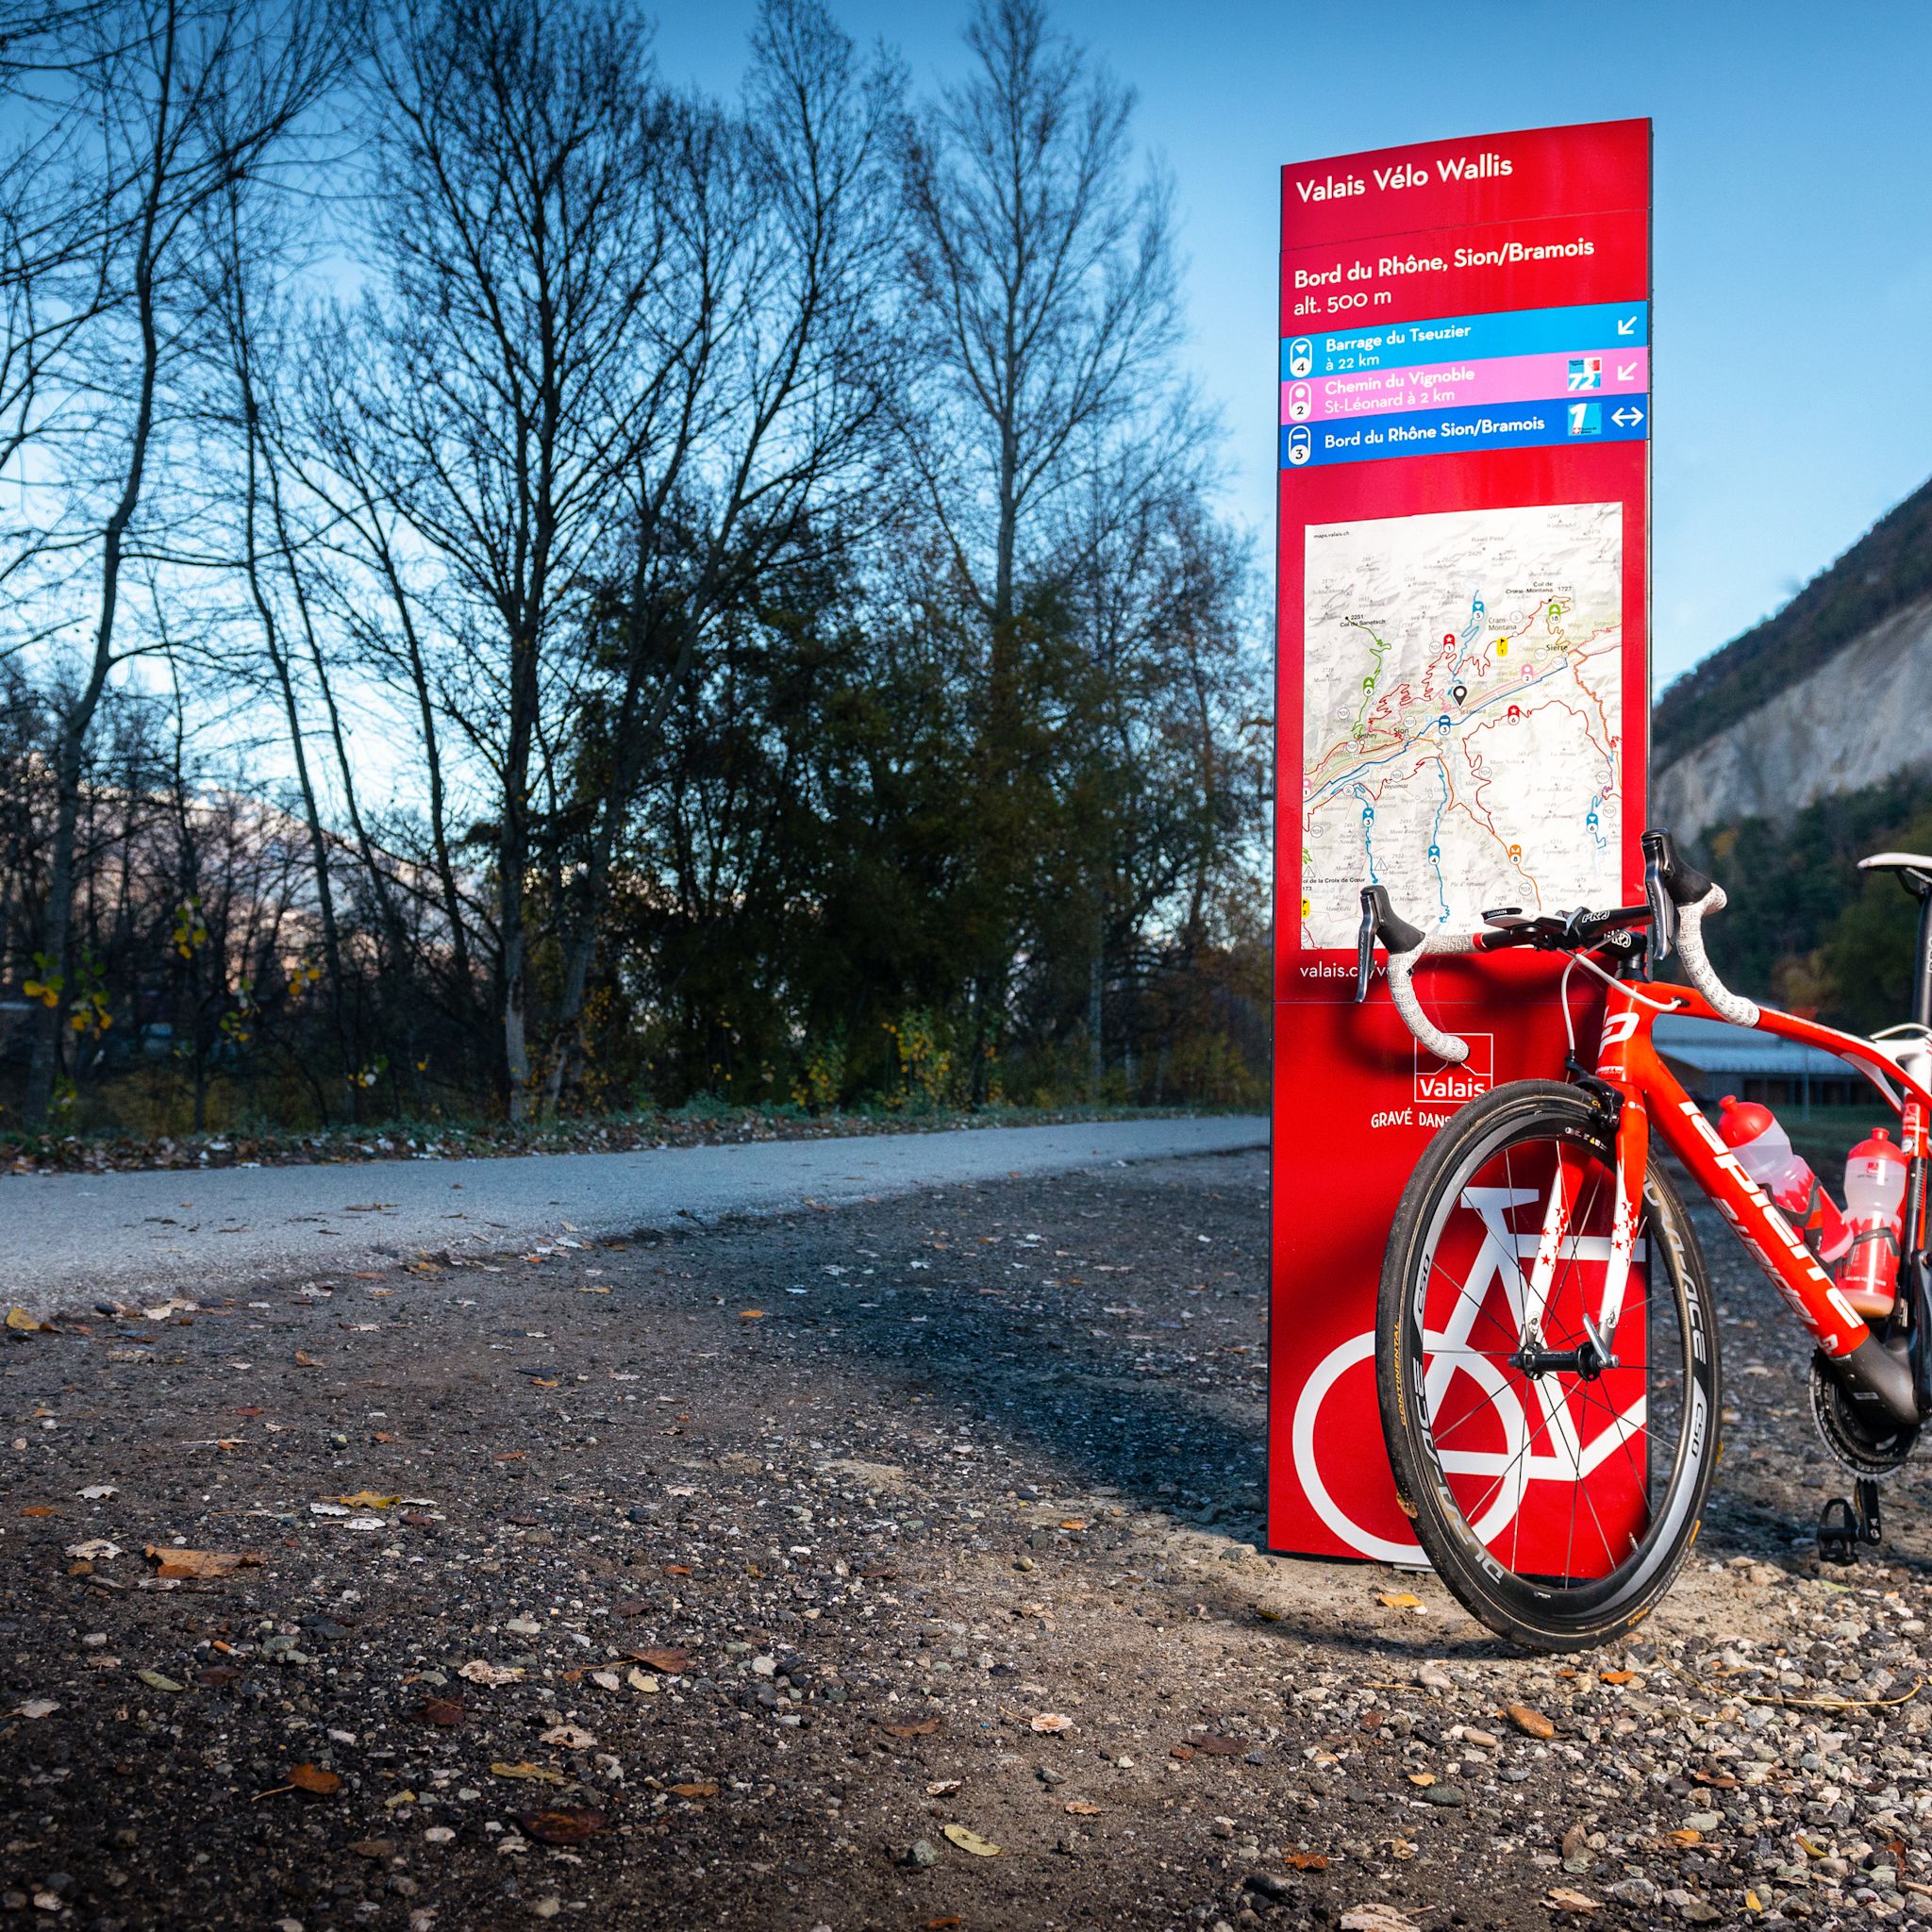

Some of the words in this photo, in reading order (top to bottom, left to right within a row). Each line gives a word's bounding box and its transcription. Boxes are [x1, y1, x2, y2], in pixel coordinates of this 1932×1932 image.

[1296, 175, 1366, 203] Valais
[1374, 164, 1429, 192] Vélo
[1436, 152, 1513, 182] Wallis
[1294, 263, 1341, 289] Bord
[1347, 259, 1373, 281] du
[1378, 253, 1448, 277] Rhône,
[1454, 238, 1595, 268] Sion/Bramois
[1293, 296, 1322, 316] alt.
[1327, 293, 1369, 313] 500
[1374, 291, 1391, 305] m
[1325, 335, 1382, 353] Barrage
[1387, 330, 1405, 345] du
[1409, 325, 1472, 342] Tseuzier
[1296, 361, 1306, 372] 4
[1325, 358, 1334, 371] à
[1338, 358, 1355, 370] 22
[1358, 354, 1380, 367] km
[1324, 378, 1382, 395] Chemin
[1386, 374, 1405, 389] du
[1408, 367, 1475, 389] Vignoble
[1568, 373, 1596, 391] 72
[1296, 406, 1304, 415] 2
[1324, 390, 1403, 413] St-Léonard
[1407, 391, 1416, 406] à
[1421, 391, 1429, 404] 2
[1434, 388, 1455, 402] km
[1570, 403, 1587, 434] 1
[1324, 431, 1361, 448] Bord
[1365, 429, 1384, 444] du
[1389, 425, 1437, 442] Rhône
[1441, 416, 1545, 440] Sion/Bramois
[1295, 448, 1303, 459] 3
[1419, 1076, 1485, 1098] Valais
[1371, 1107, 1413, 1128] GRAVÉ
